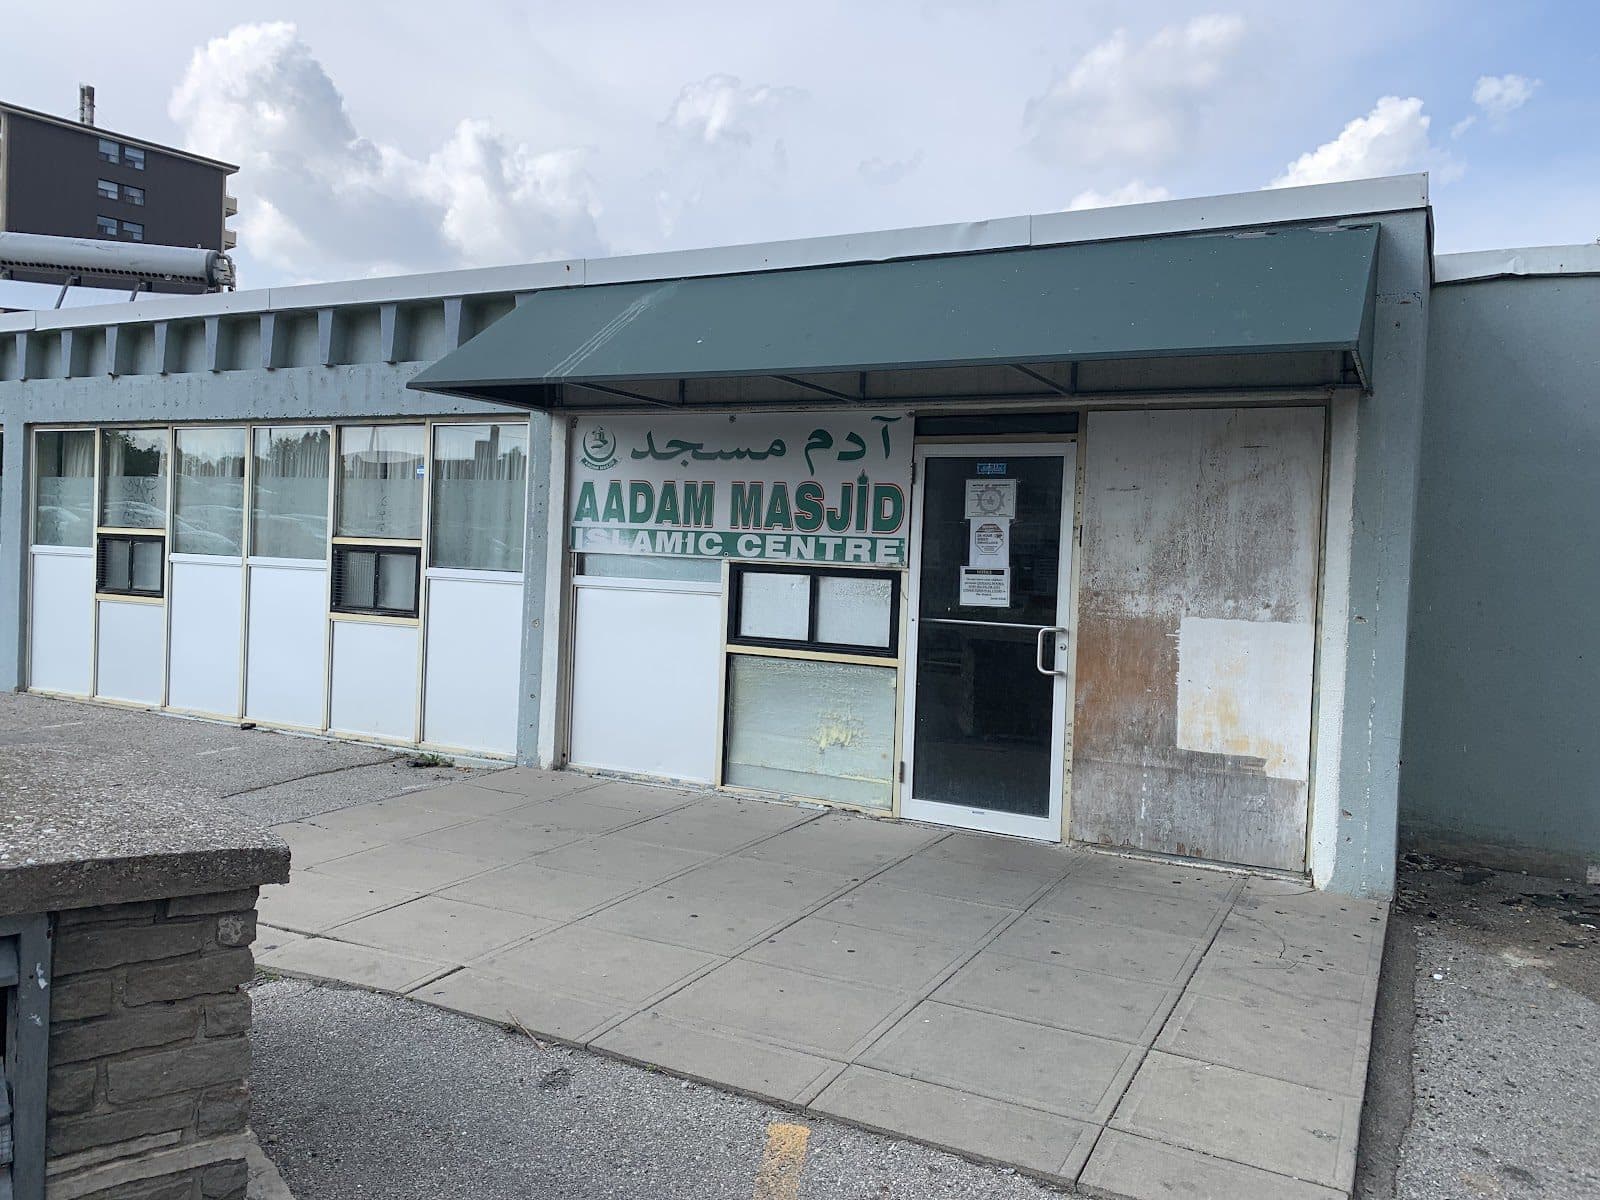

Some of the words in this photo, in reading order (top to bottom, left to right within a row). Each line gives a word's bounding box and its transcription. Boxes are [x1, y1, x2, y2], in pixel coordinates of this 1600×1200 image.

[630, 430, 787, 467] مسجد
[804, 415, 902, 476] آدم
[574, 480, 716, 528] AADAM
[729, 474, 906, 534] MASJID
[574, 527, 723, 556] ISLAMIC
[736, 534, 901, 563] CENTRE
